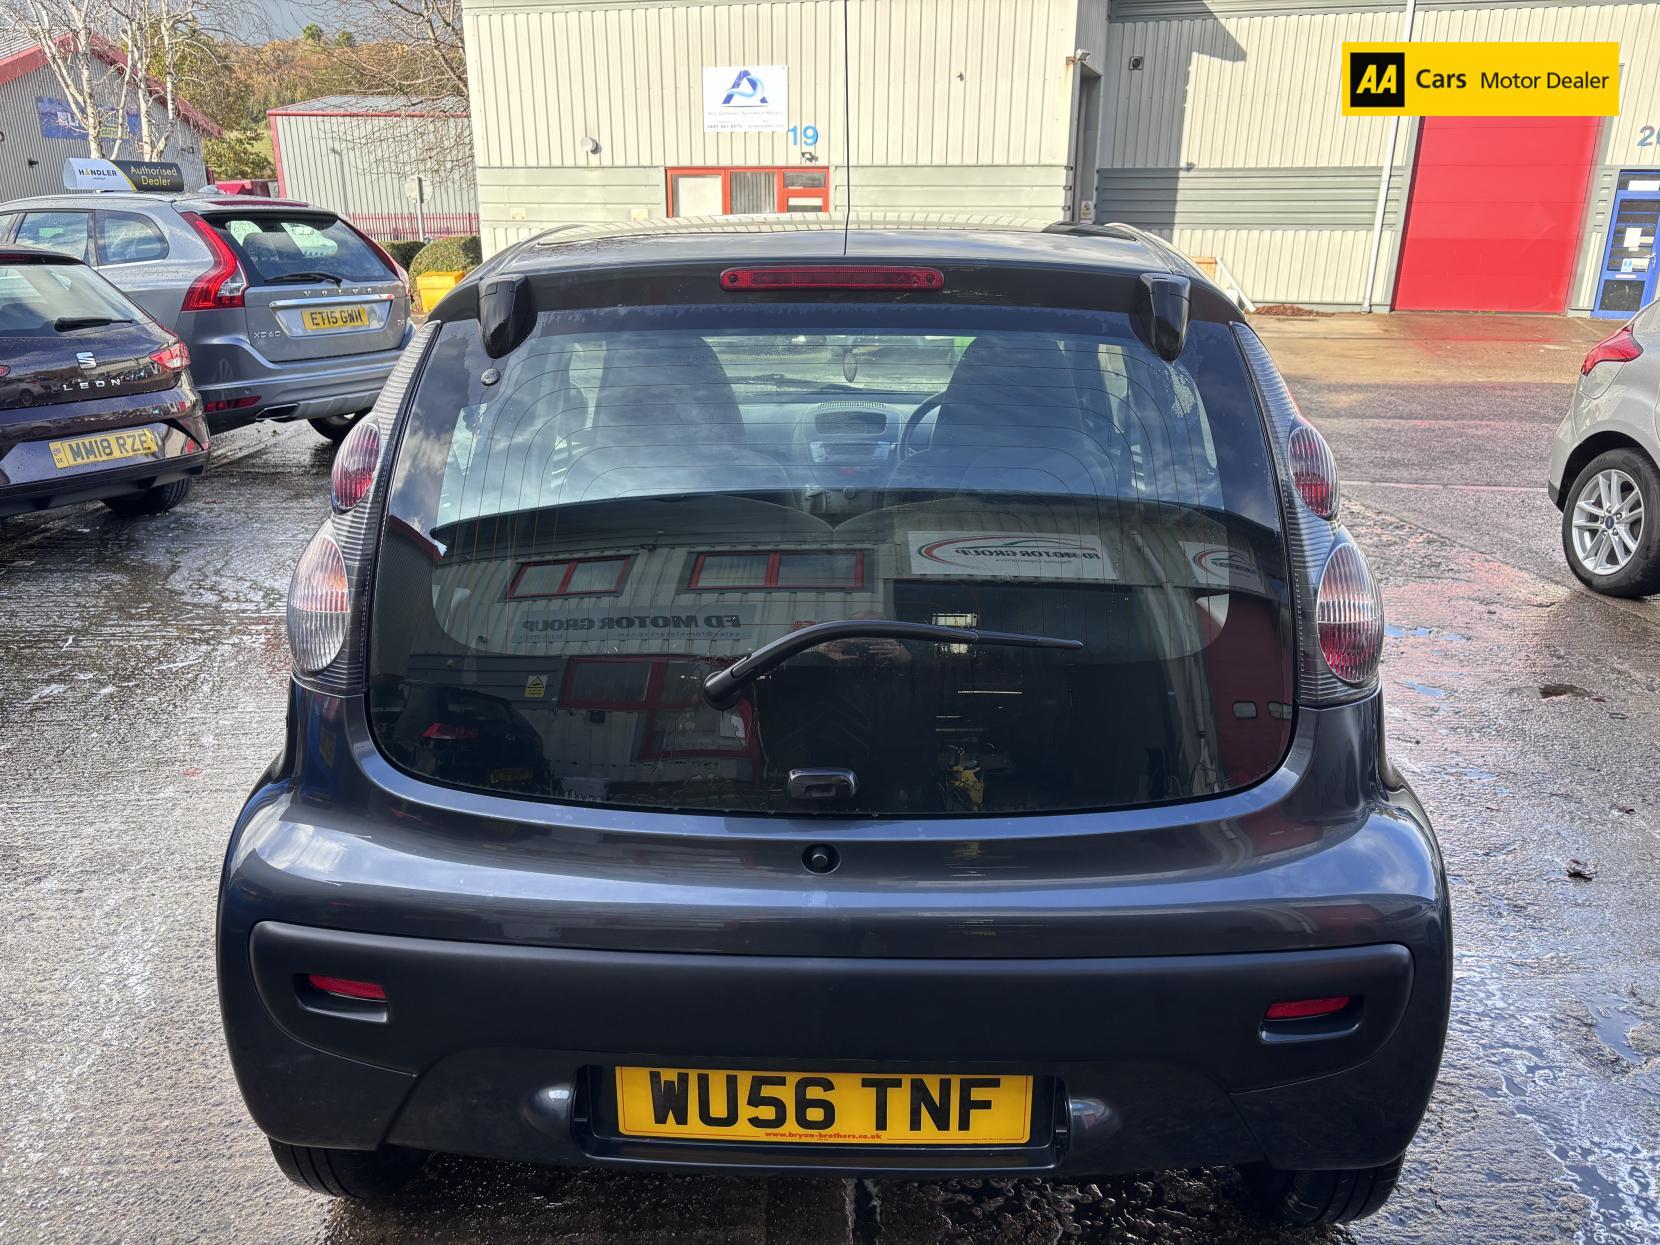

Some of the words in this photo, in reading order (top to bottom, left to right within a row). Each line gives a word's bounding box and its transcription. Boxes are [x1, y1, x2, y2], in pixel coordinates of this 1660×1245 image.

[787, 125, 820, 147] 19
[130, 165, 177, 176] Authorised
[141, 175, 171, 186] Dealer
[303, 287, 373, 297] VOLVO
[310, 310, 338, 326] ET15
[62, 378, 121, 392] LEON
[68, 438, 114, 462] MM18
[116, 432, 151, 455] RZE
[649, 1070, 836, 1131] WU56
[861, 1077, 1001, 1132] TNF
[764, 1131, 882, 1140] www.bryan-brothers.co.uk
